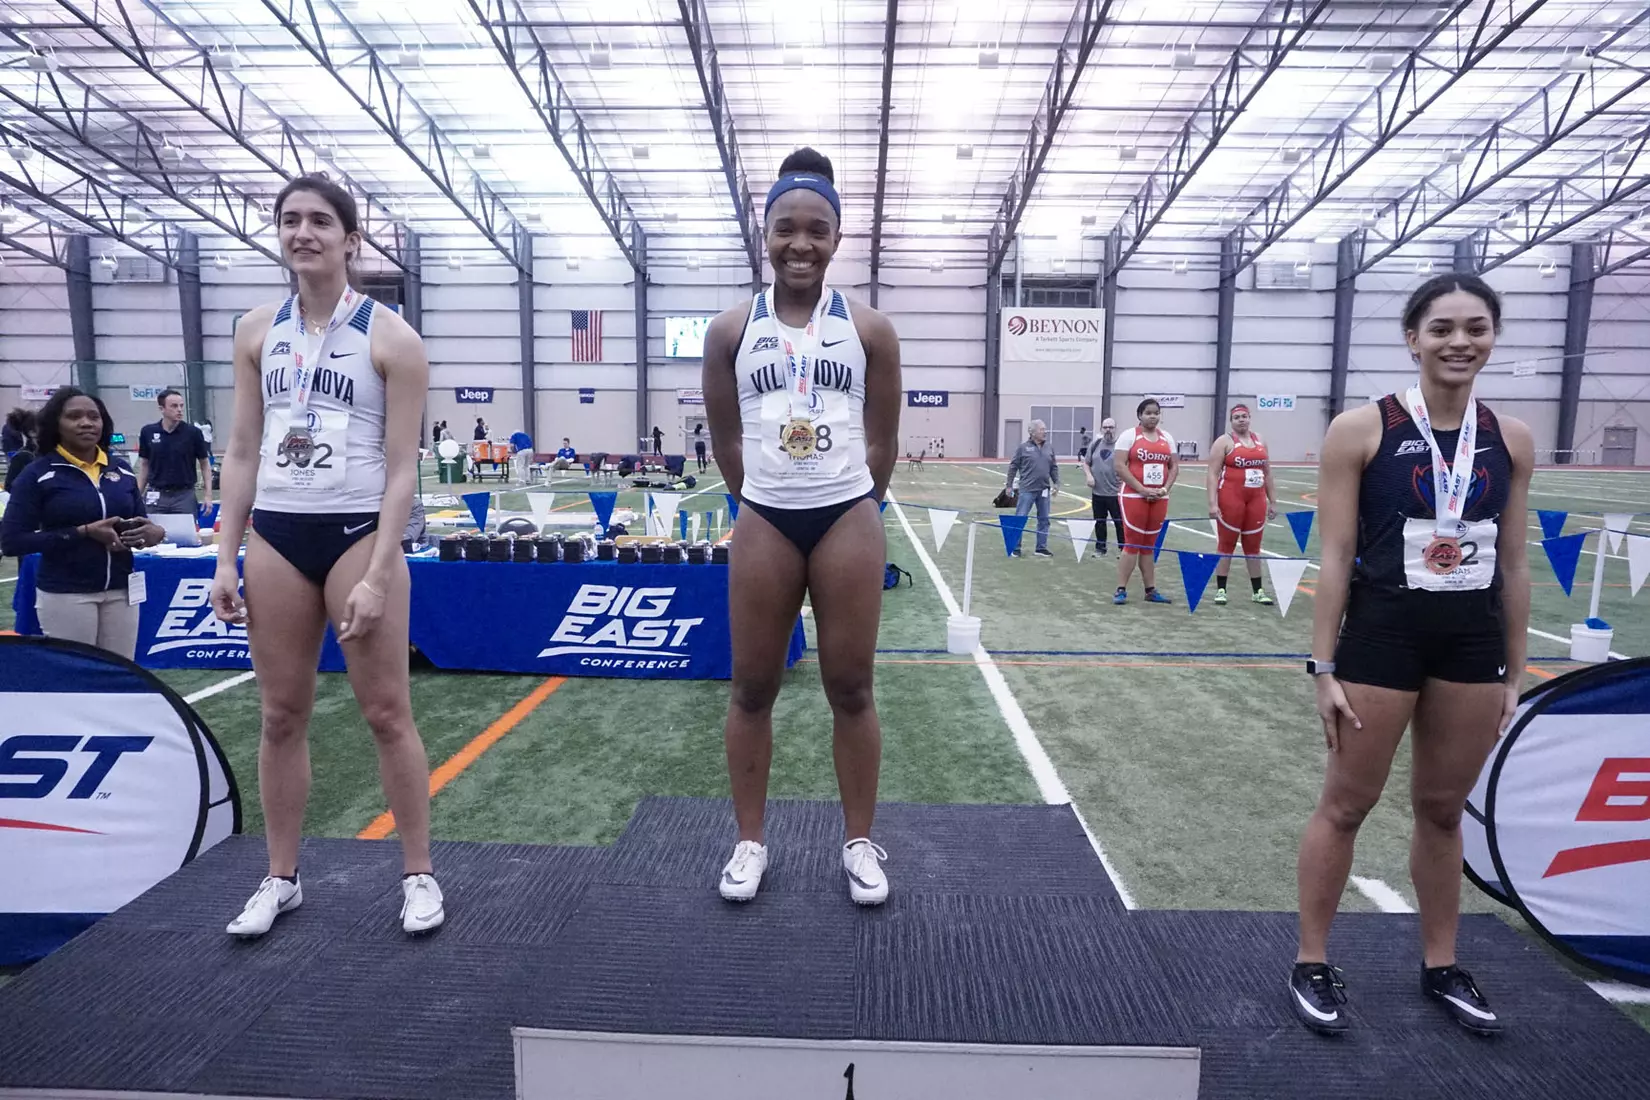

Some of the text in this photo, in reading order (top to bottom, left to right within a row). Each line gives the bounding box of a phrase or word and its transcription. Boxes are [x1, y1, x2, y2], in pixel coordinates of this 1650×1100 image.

[1029, 319, 1100, 334] BEYNON
[757, 336, 779, 344] BIG
[750, 359, 854, 394] VILNOVA
[132, 388, 154, 398] SoFi
[265, 366, 355, 406] VILNOVA
[460, 388, 489, 402] Jeep
[913, 392, 943, 405] Jeep
[1259, 397, 1282, 408] SoFi
[276, 443, 333, 469] 52
[289, 469, 316, 477] JONES
[1452, 472, 1462, 497] EAST
[566, 584, 677, 617] BIG
[155, 609, 249, 638] EA
[549, 615, 705, 647] EAST
[186, 650, 252, 659] CONFERE
[580, 657, 690, 669] CONFERENCE
[843, 1062, 855, 1100] 1
